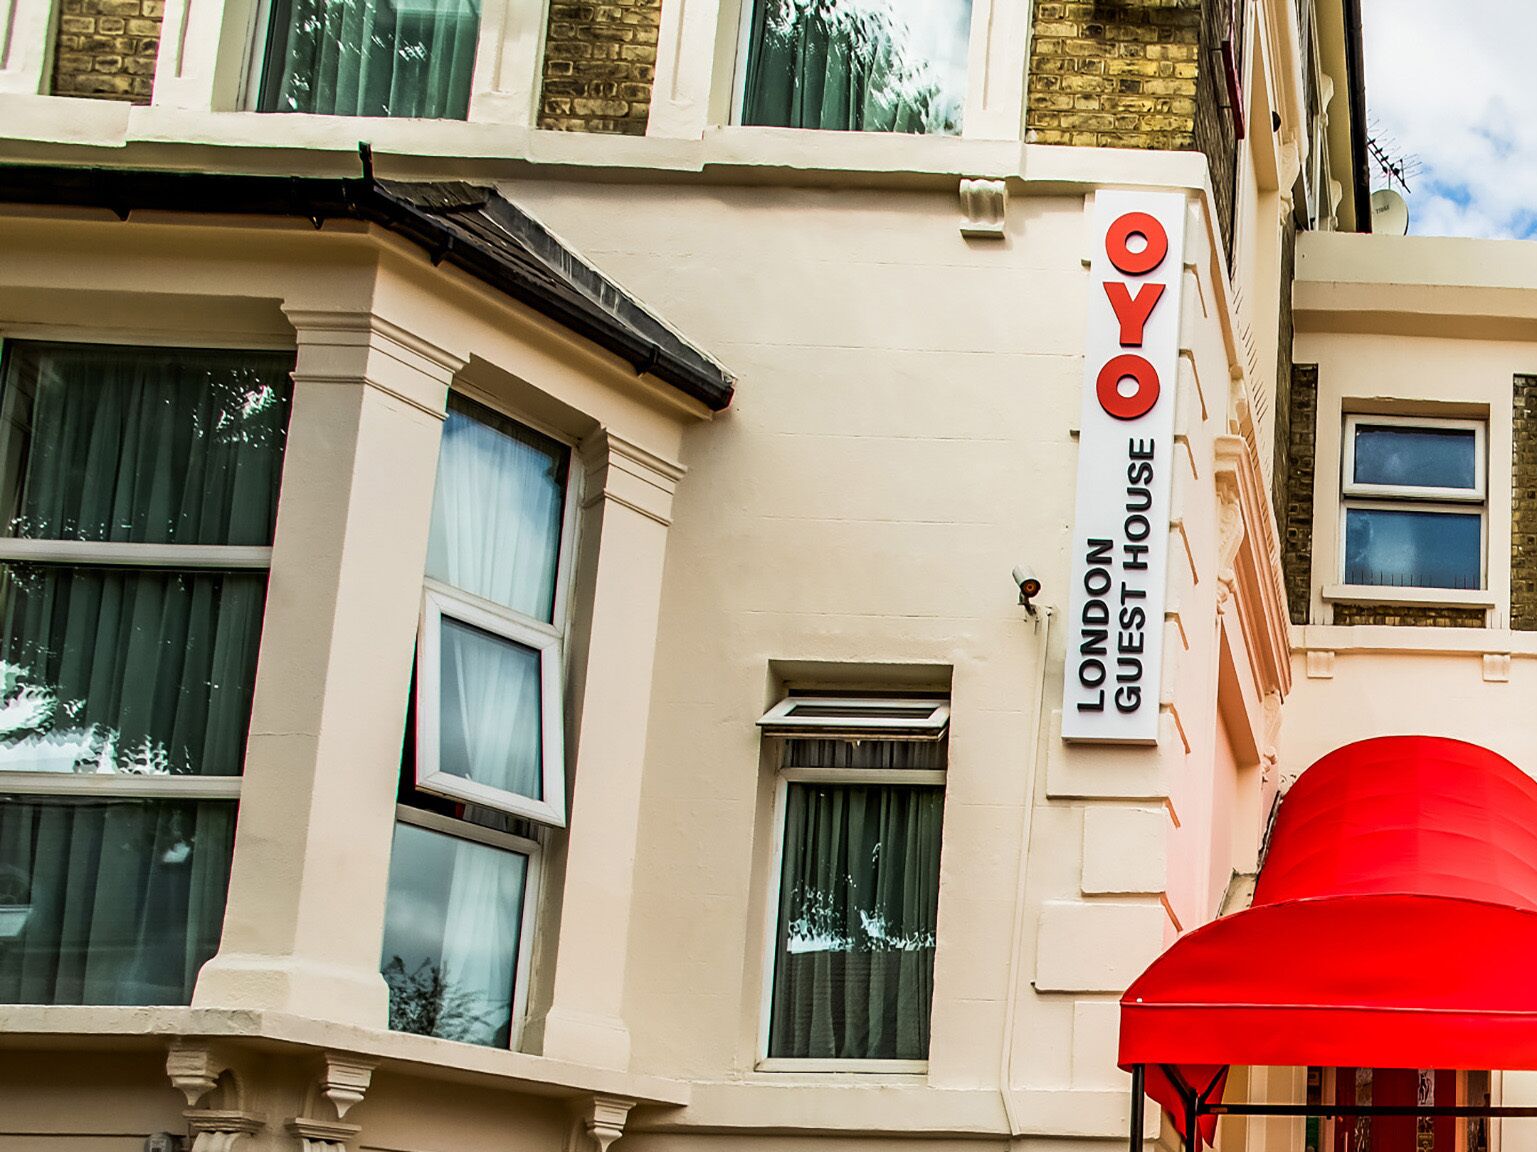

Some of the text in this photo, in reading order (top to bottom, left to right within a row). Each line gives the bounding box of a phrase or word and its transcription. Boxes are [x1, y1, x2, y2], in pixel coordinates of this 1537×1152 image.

[1097, 211, 1169, 421] OYO
[1076, 538, 1114, 713] LONDON
[1114, 438, 1155, 714] GUEST HOUSE
